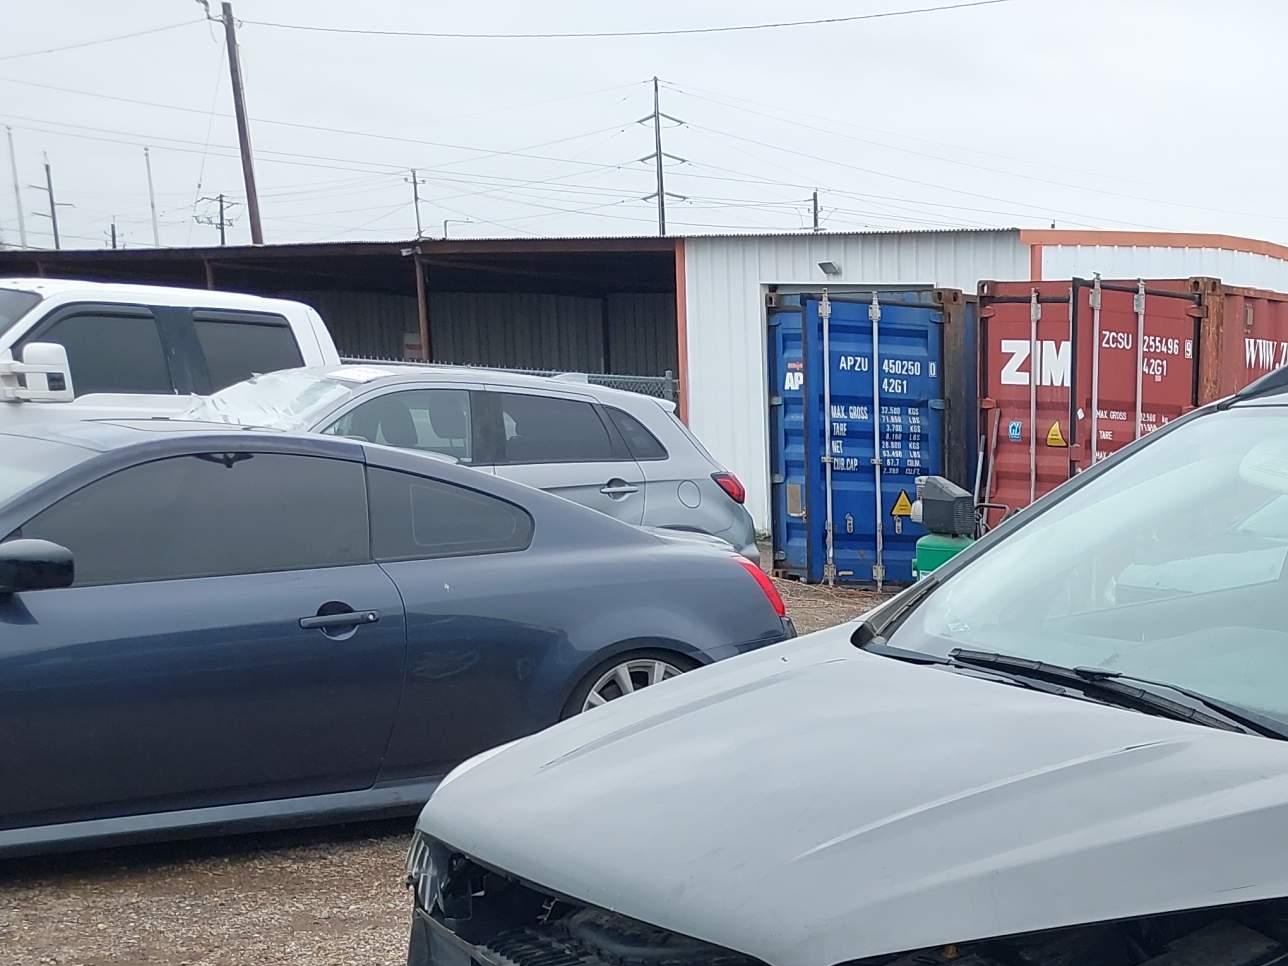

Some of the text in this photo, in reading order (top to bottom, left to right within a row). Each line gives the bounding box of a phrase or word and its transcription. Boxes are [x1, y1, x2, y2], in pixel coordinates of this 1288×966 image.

[1102, 330, 1132, 350] ZCSU
[1143, 336, 1179, 355] 255496
[839, 355, 937, 377] APZU 450250 0
[1001, 339, 1071, 386] ZIM
[1143, 358, 1167, 376] 42G1
[882, 378, 907, 394] 42G1
[848, 406, 868, 420] GROSS
[908, 407, 919, 416] KGS
[1109, 411, 1127, 421] GROSS
[832, 422, 848, 436] TARE
[1098, 430, 1113, 440] TARE
[831, 440, 843, 454] NET
